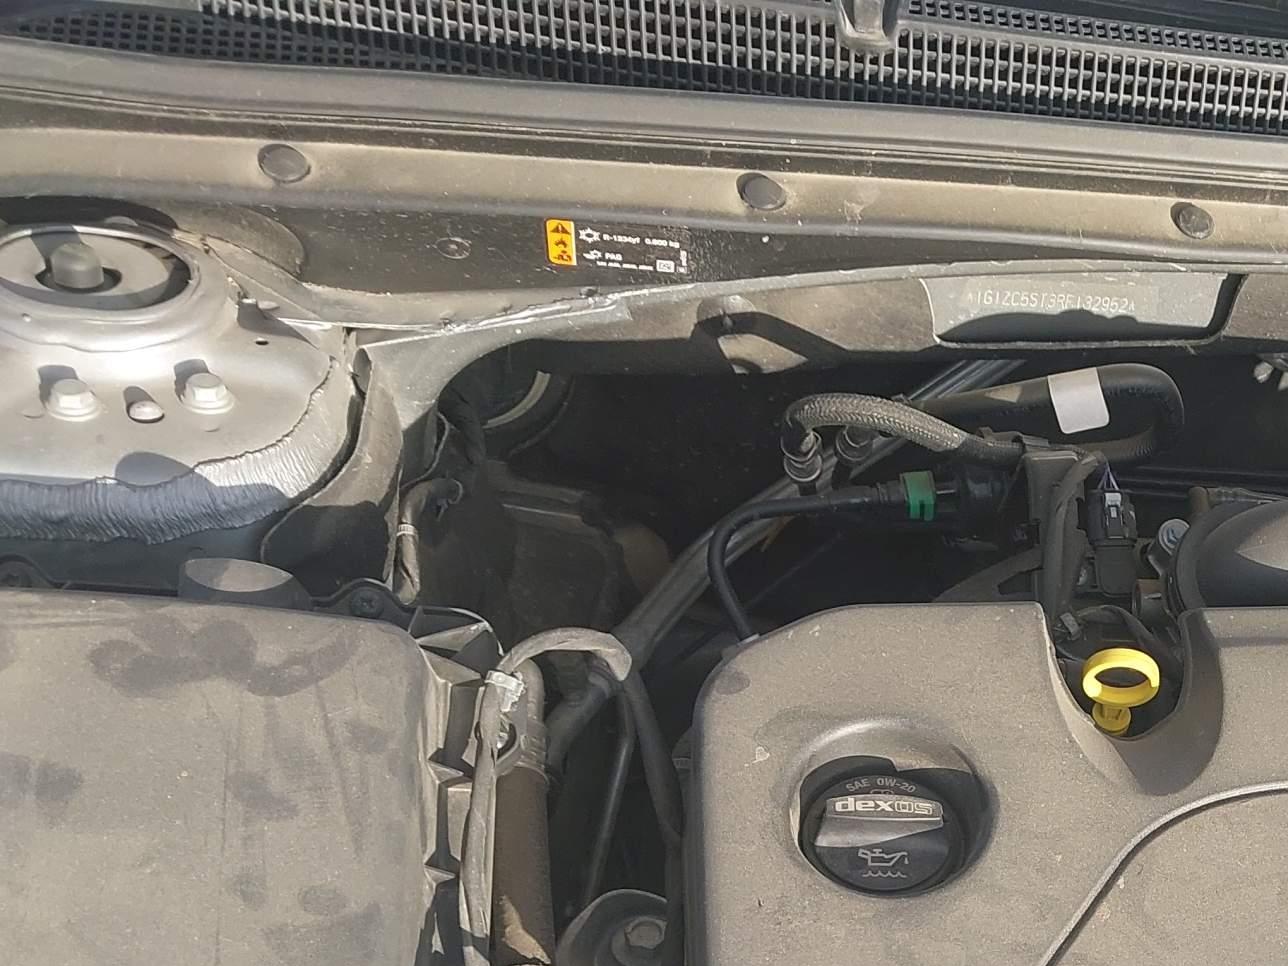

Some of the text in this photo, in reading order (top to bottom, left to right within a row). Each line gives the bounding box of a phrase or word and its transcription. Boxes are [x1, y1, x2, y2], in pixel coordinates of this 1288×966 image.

[845, 777, 917, 793] SAE 0W-20
[835, 797, 933, 815] dexos
